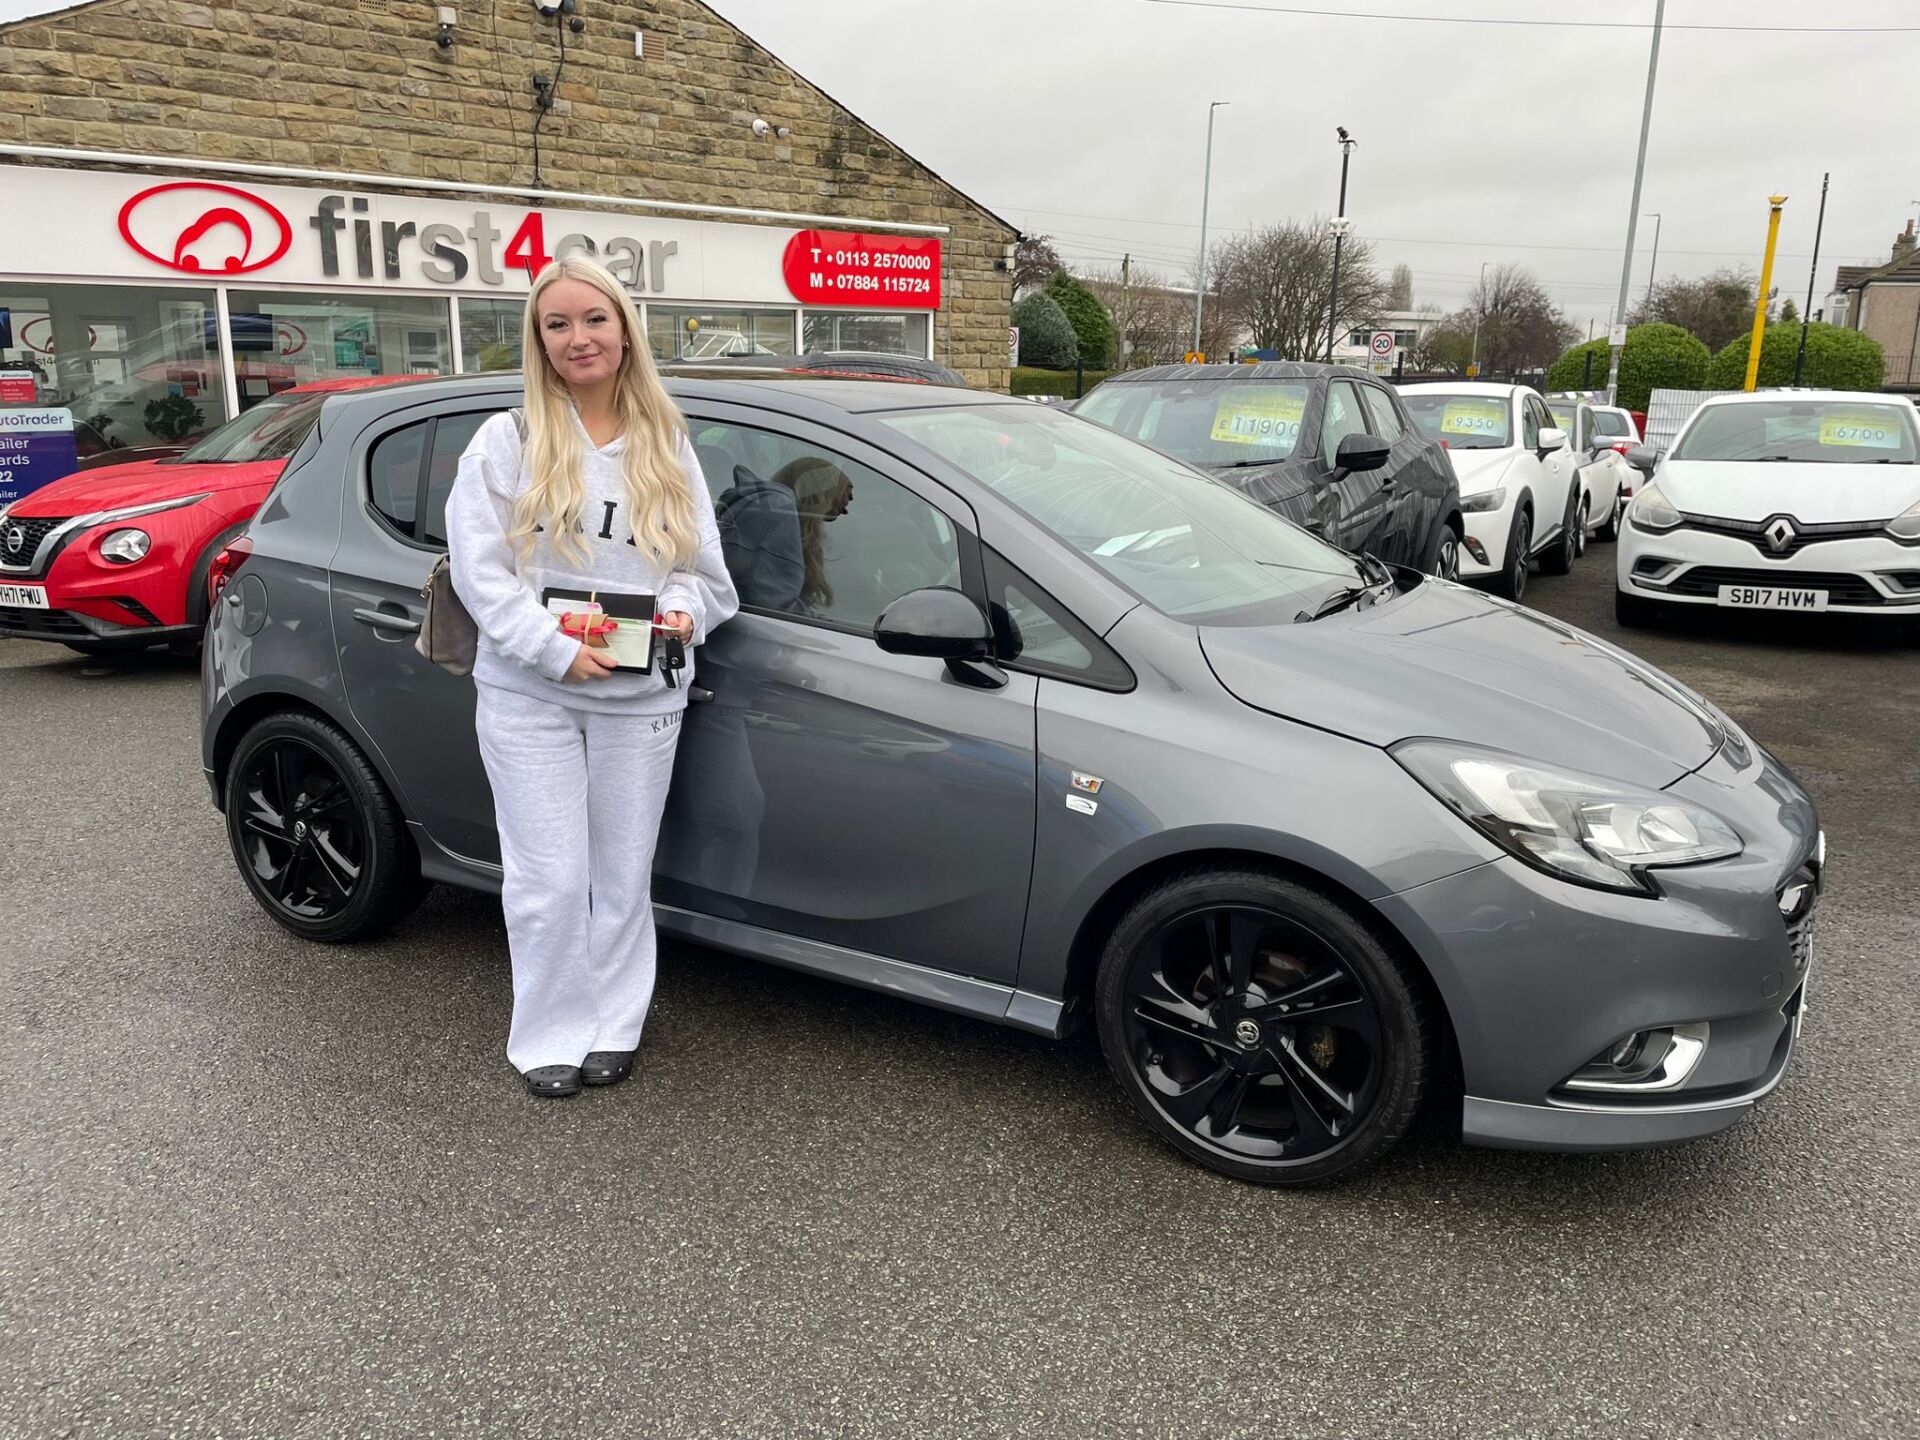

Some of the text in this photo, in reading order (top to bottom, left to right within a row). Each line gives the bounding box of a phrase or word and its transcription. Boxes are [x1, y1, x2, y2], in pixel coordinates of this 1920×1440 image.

[810, 248, 931, 270] T 0113 2570000
[809, 272, 931, 293] M 07884 115724
[1376, 338, 1390, 349] 20
[1730, 588, 1816, 608] SB17 HVM
